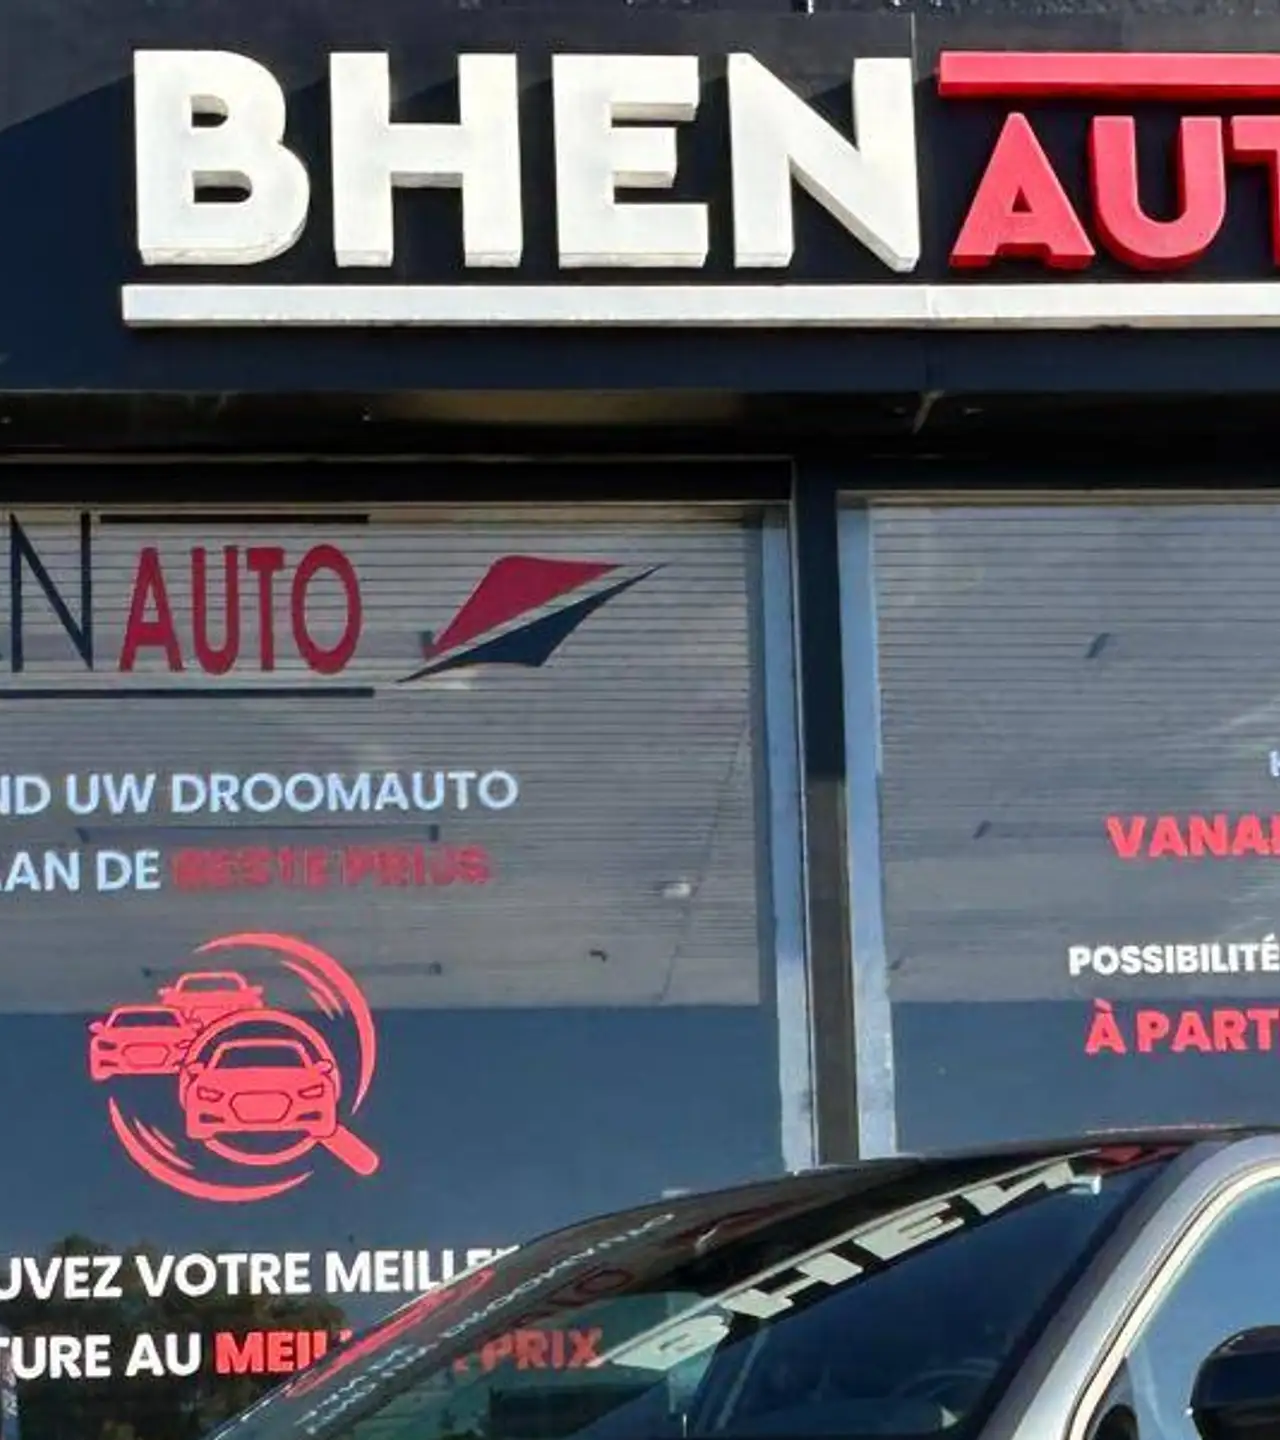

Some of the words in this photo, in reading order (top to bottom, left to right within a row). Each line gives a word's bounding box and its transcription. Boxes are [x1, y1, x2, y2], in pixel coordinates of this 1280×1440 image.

[133, 49, 919, 272] BHEN
[119, 543, 363, 677] AUTO
[66, 773, 157, 815] UW
[170, 769, 520, 815] DROOMAUTO
[96, 849, 161, 892] DE
[173, 846, 332, 891] BESTE
[341, 843, 492, 888] PRIJS
[1084, 999, 1127, 1056] À
[134, 1250, 312, 1298] VOTRE
[123, 1332, 202, 1377] AU
[480, 1327, 595, 1374] PRIX
